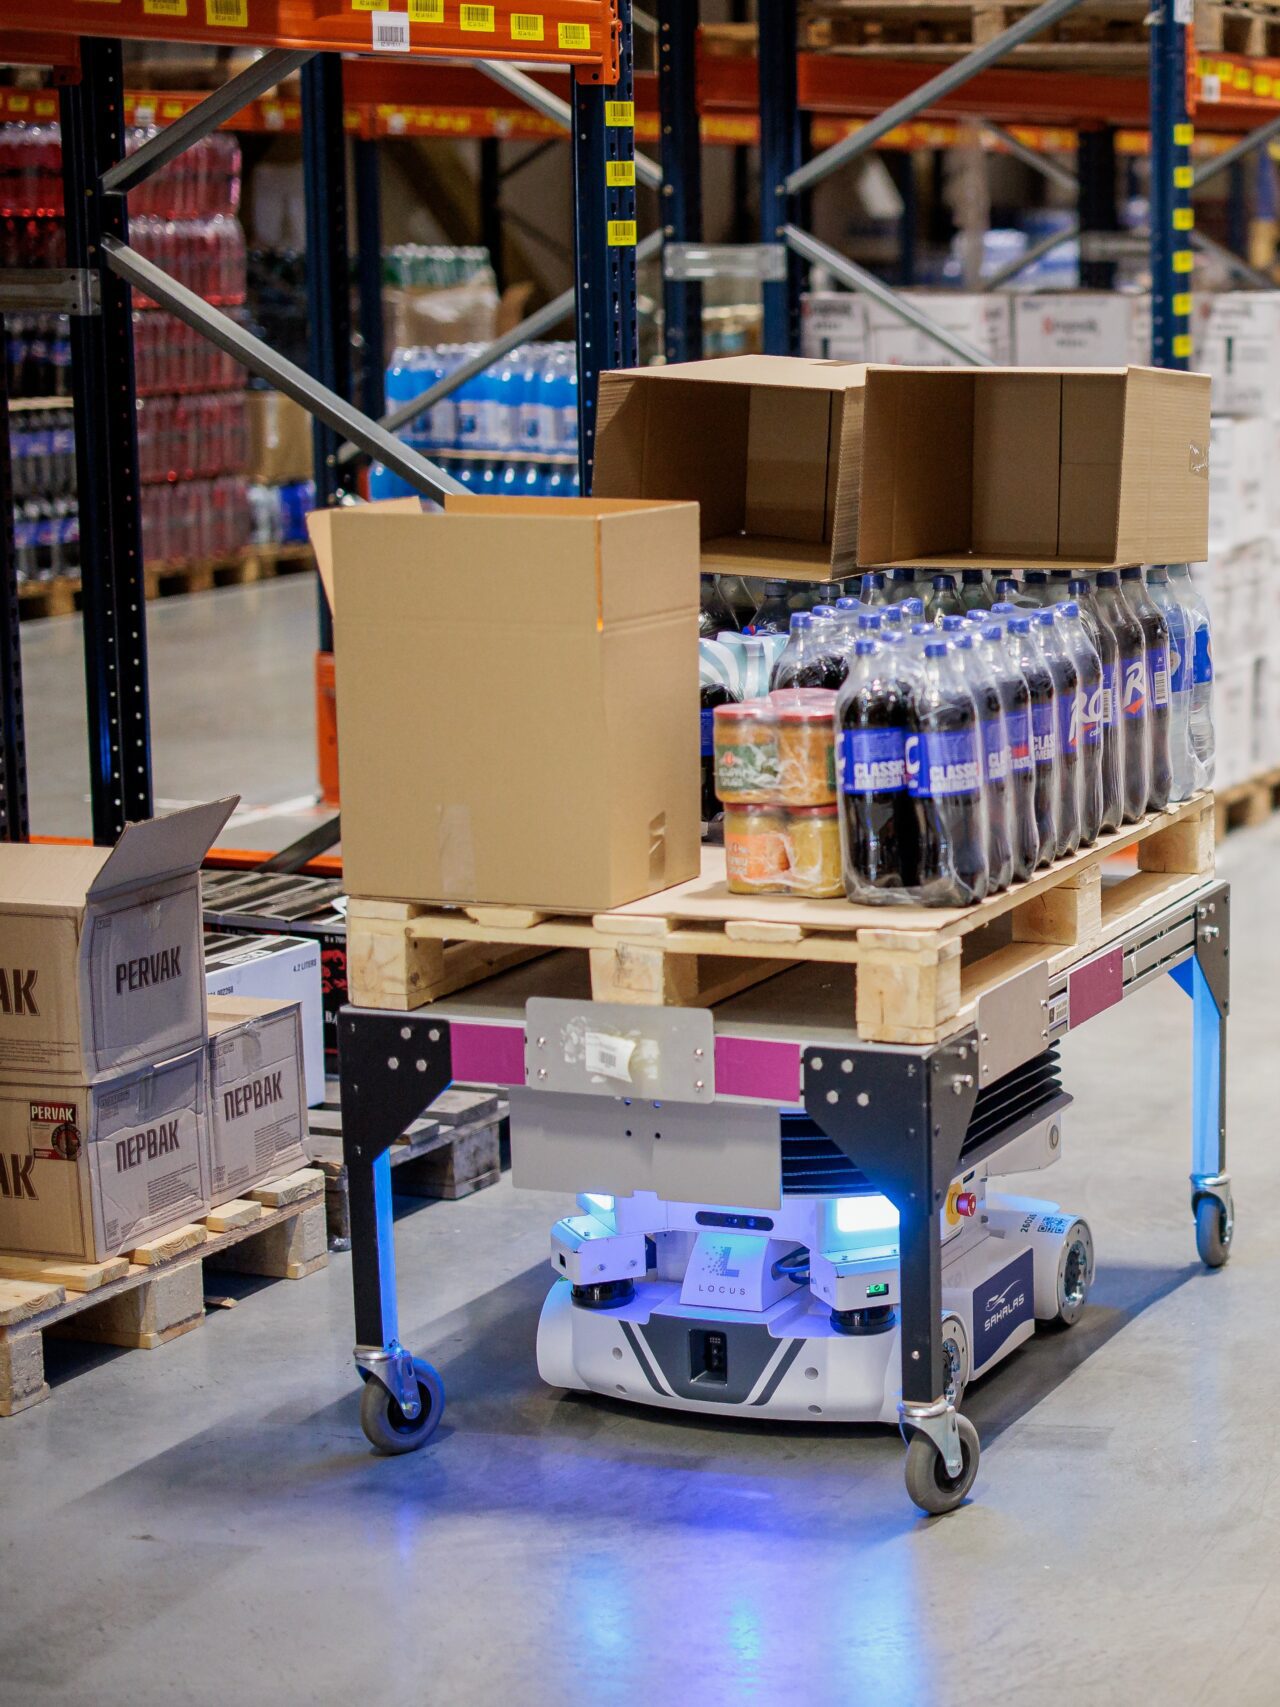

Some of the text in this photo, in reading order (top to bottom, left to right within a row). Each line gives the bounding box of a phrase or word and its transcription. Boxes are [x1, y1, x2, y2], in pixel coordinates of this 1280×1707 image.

[116, 946, 182, 996] PERVAK
[31, 1105, 74, 1121] PERVAK
[223, 1070, 283, 1122] ПЕРВАК
[116, 1119, 180, 1173] ПЕРВАК
[698, 1284, 746, 1296] LOCUS
